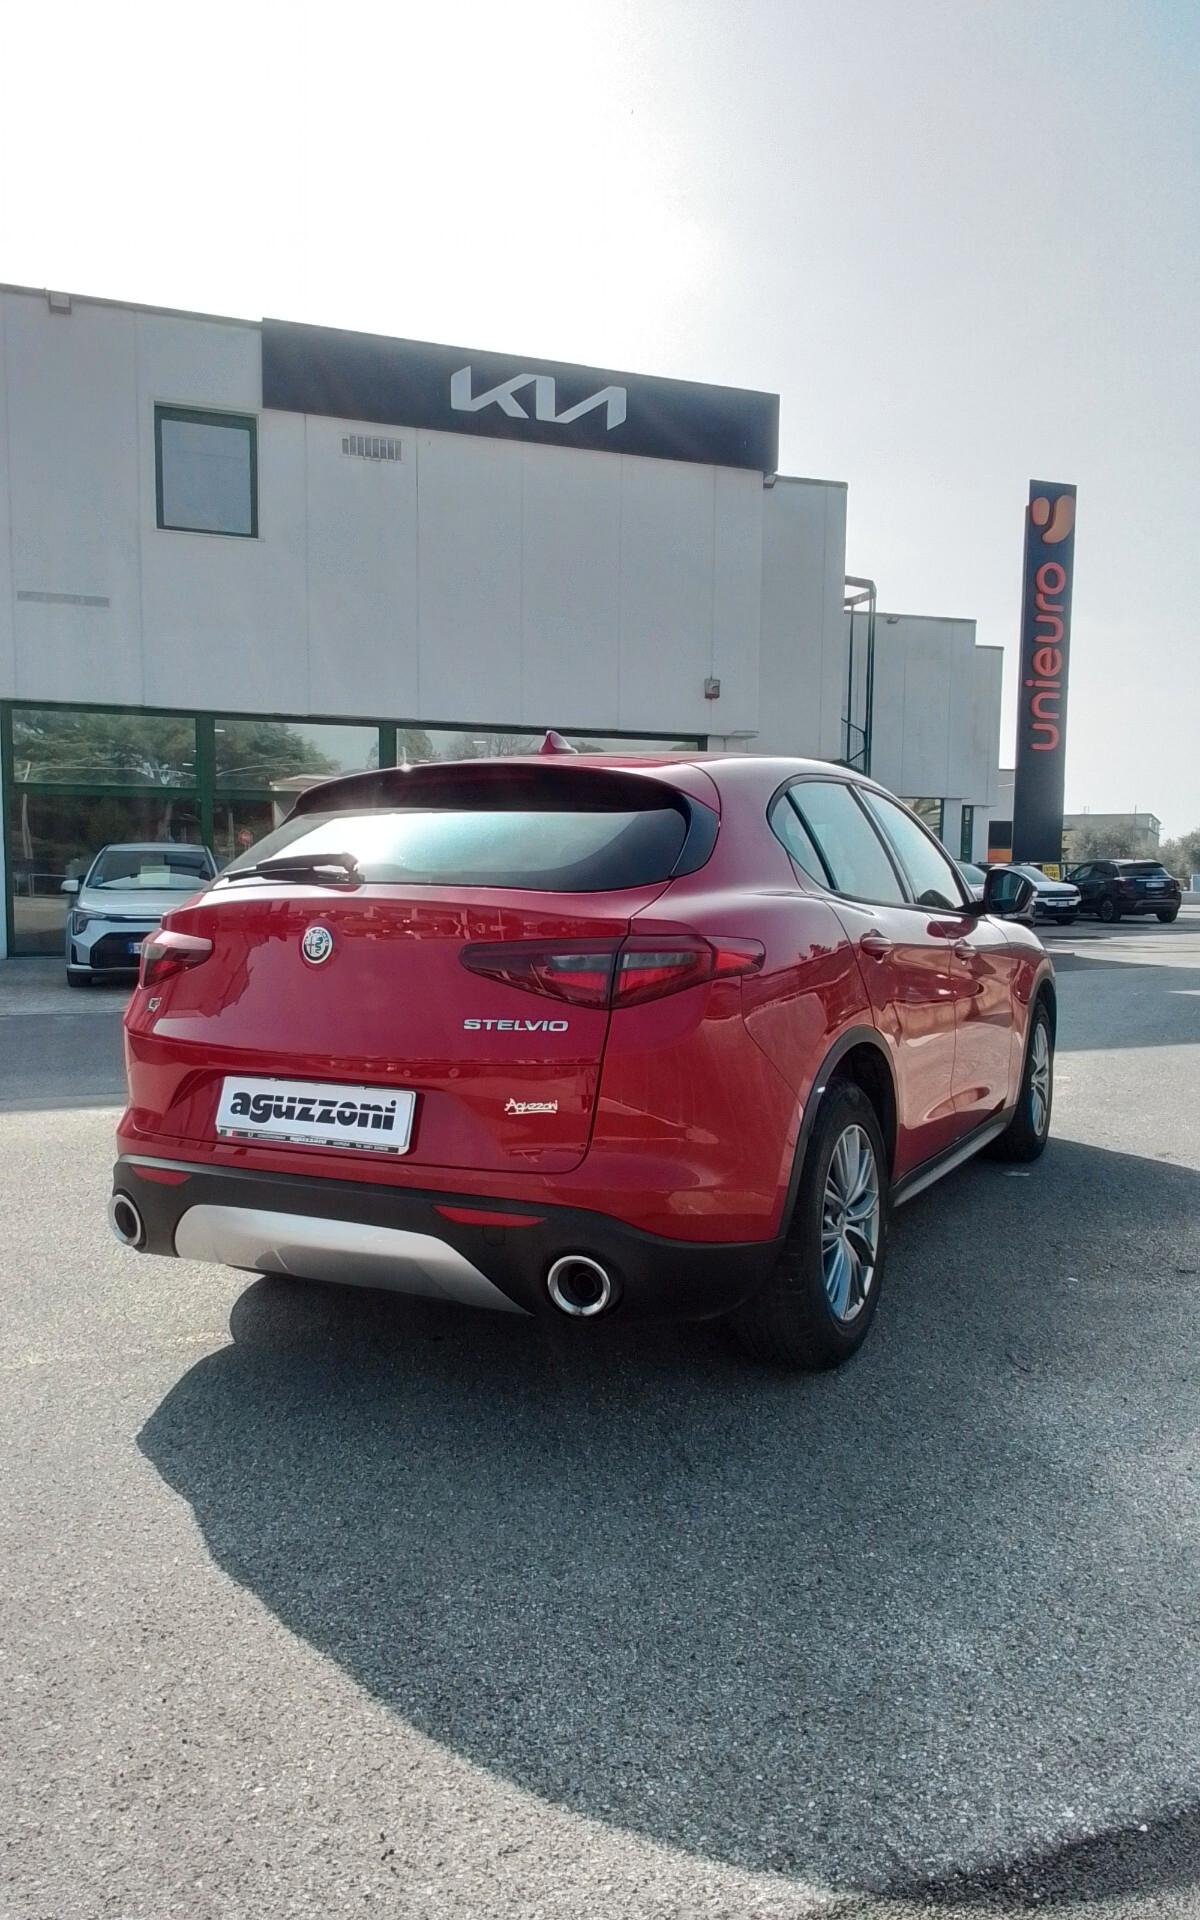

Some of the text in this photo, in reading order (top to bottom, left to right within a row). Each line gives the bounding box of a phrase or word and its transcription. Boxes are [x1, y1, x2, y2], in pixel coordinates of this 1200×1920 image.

[450, 365, 627, 431] KIA
[1025, 561, 1066, 751] unieuro
[463, 1018, 569, 1032] STELVIO
[230, 1091, 397, 1131] aguzzoni
